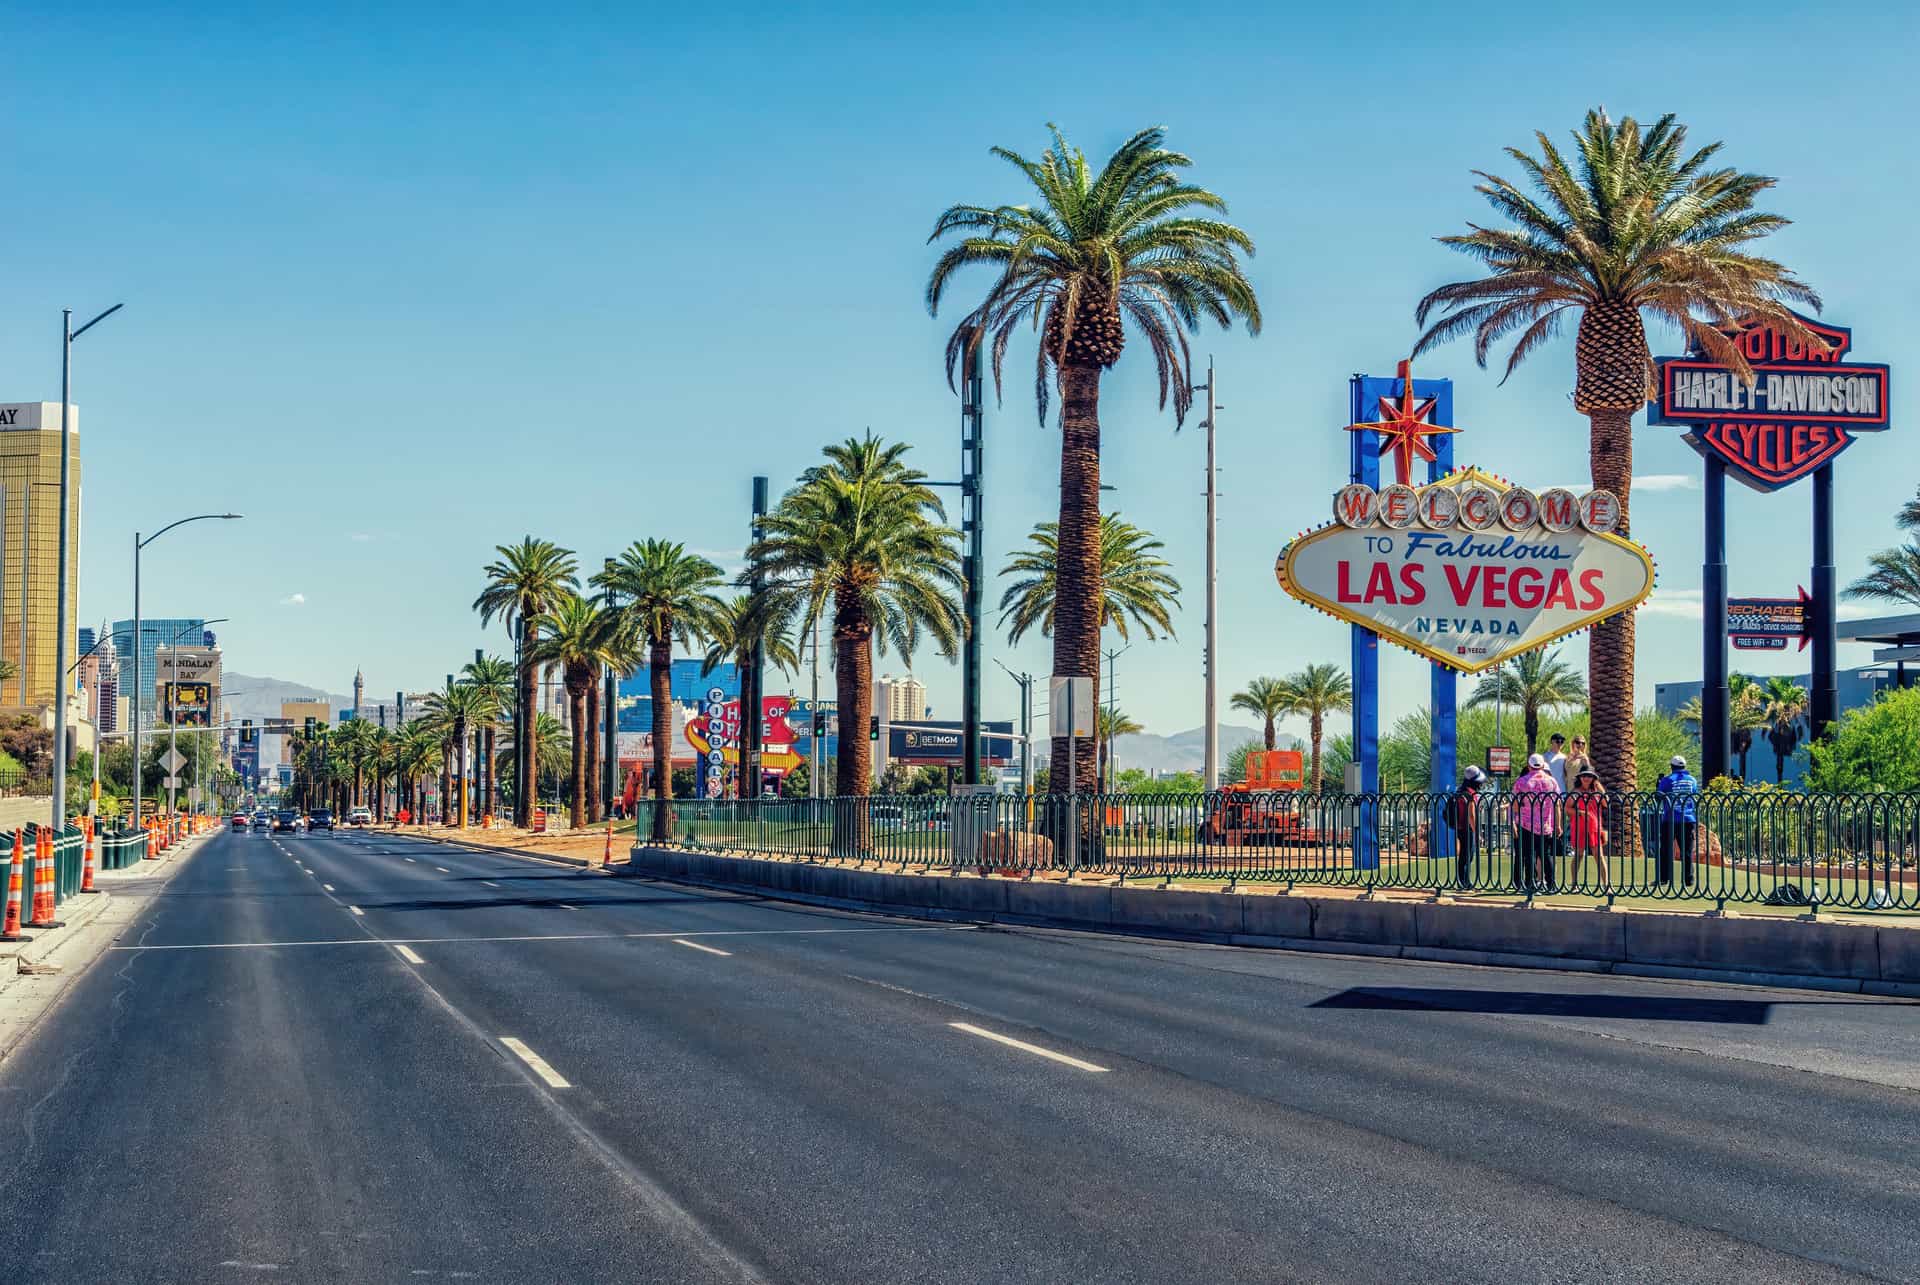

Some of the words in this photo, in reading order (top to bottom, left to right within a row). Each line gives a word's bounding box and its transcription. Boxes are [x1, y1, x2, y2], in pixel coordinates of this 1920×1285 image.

[1674, 371, 1877, 414] HARLEY-DAVIDSON
[1721, 423, 1830, 472] CYCLES
[1342, 492, 1612, 527] WELCOME
[1364, 536, 1393, 554] TO
[1404, 531, 1571, 561] Fabulous
[1336, 560, 1427, 607] LAS
[1443, 564, 1606, 611] VEGAS
[1416, 617, 1520, 636] NEVADA
[1737, 638, 1752, 646] FREE
[1770, 639, 1784, 647] ATM
[180, 671, 197, 679] BAY
[769, 707, 785, 717] OF
[727, 722, 772, 737] FE
[921, 735, 958, 744] BETMGM
